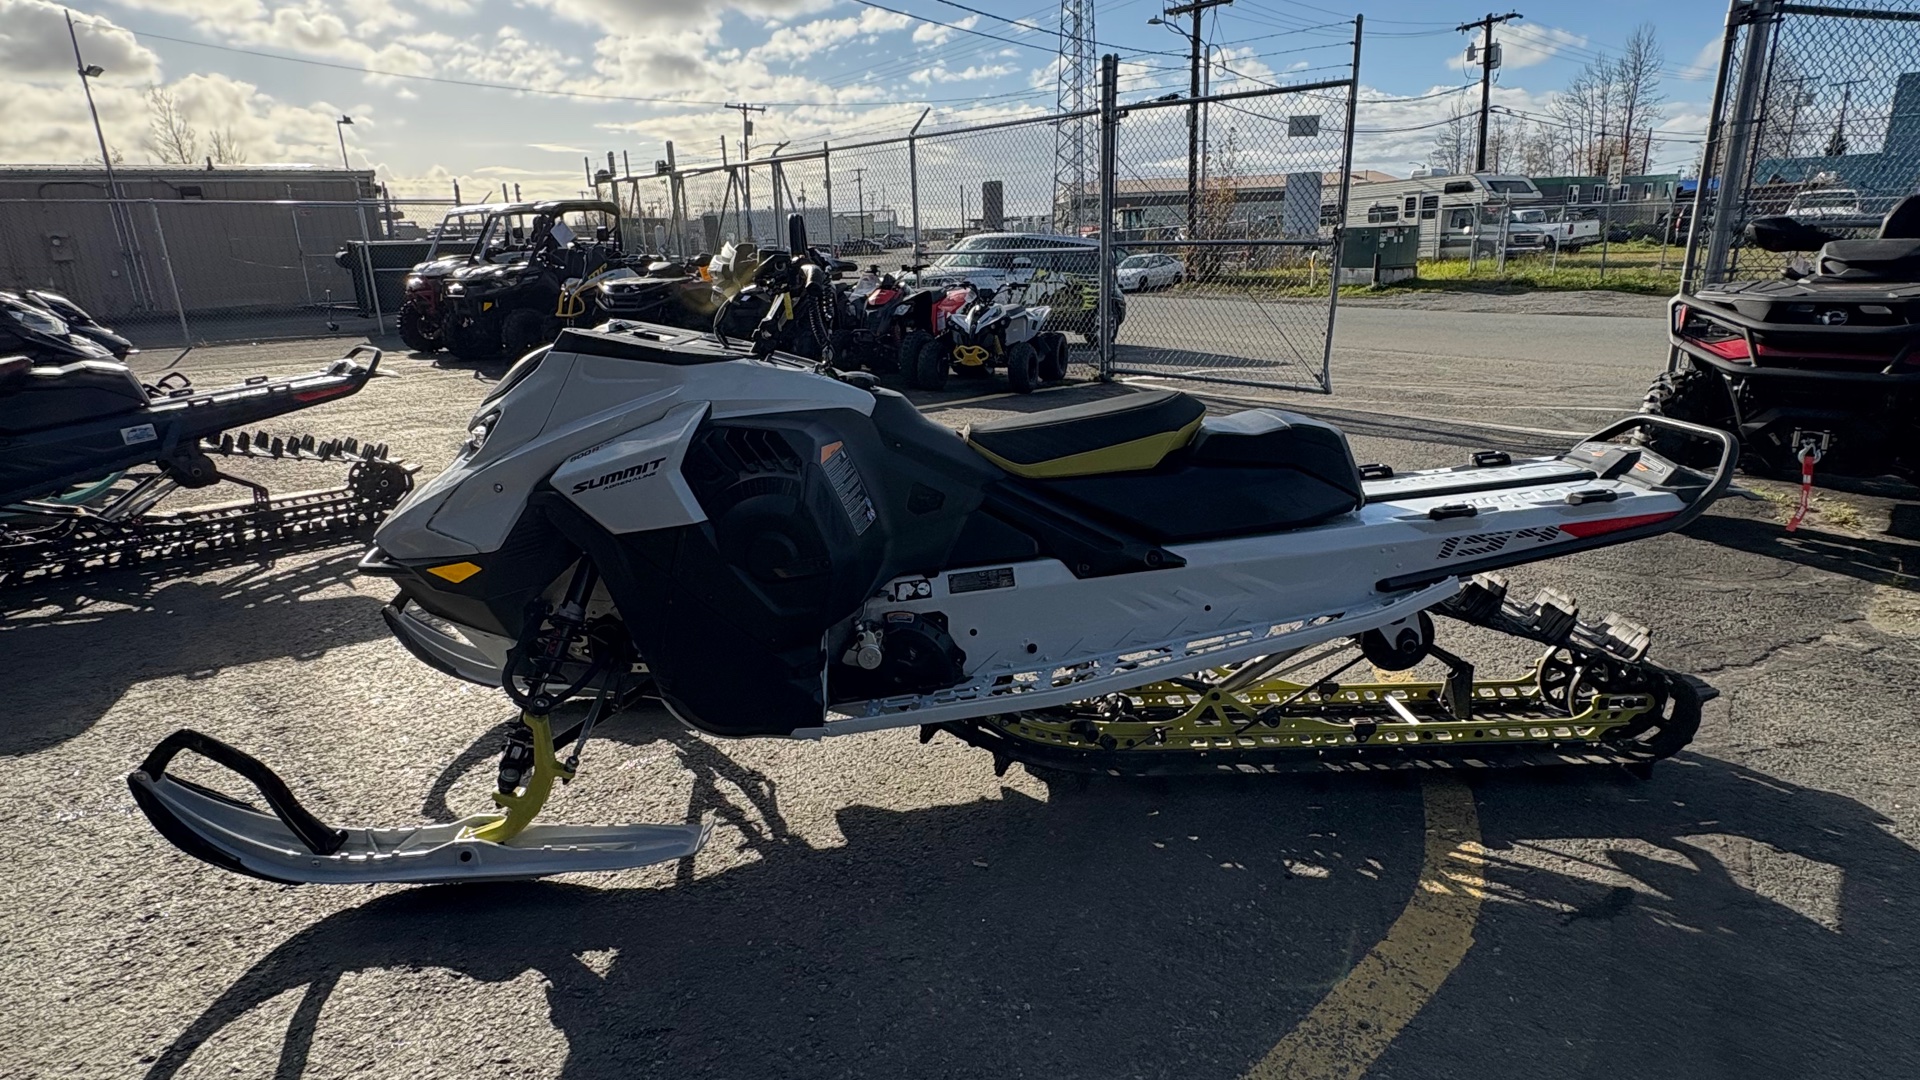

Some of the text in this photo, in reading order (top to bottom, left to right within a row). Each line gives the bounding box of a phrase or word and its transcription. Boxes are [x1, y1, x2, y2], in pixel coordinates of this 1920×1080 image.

[1608, 173, 1620, 186] 25
[572, 457, 667, 495] SUMMIT
[602, 471, 657, 491] ADRENALINE
